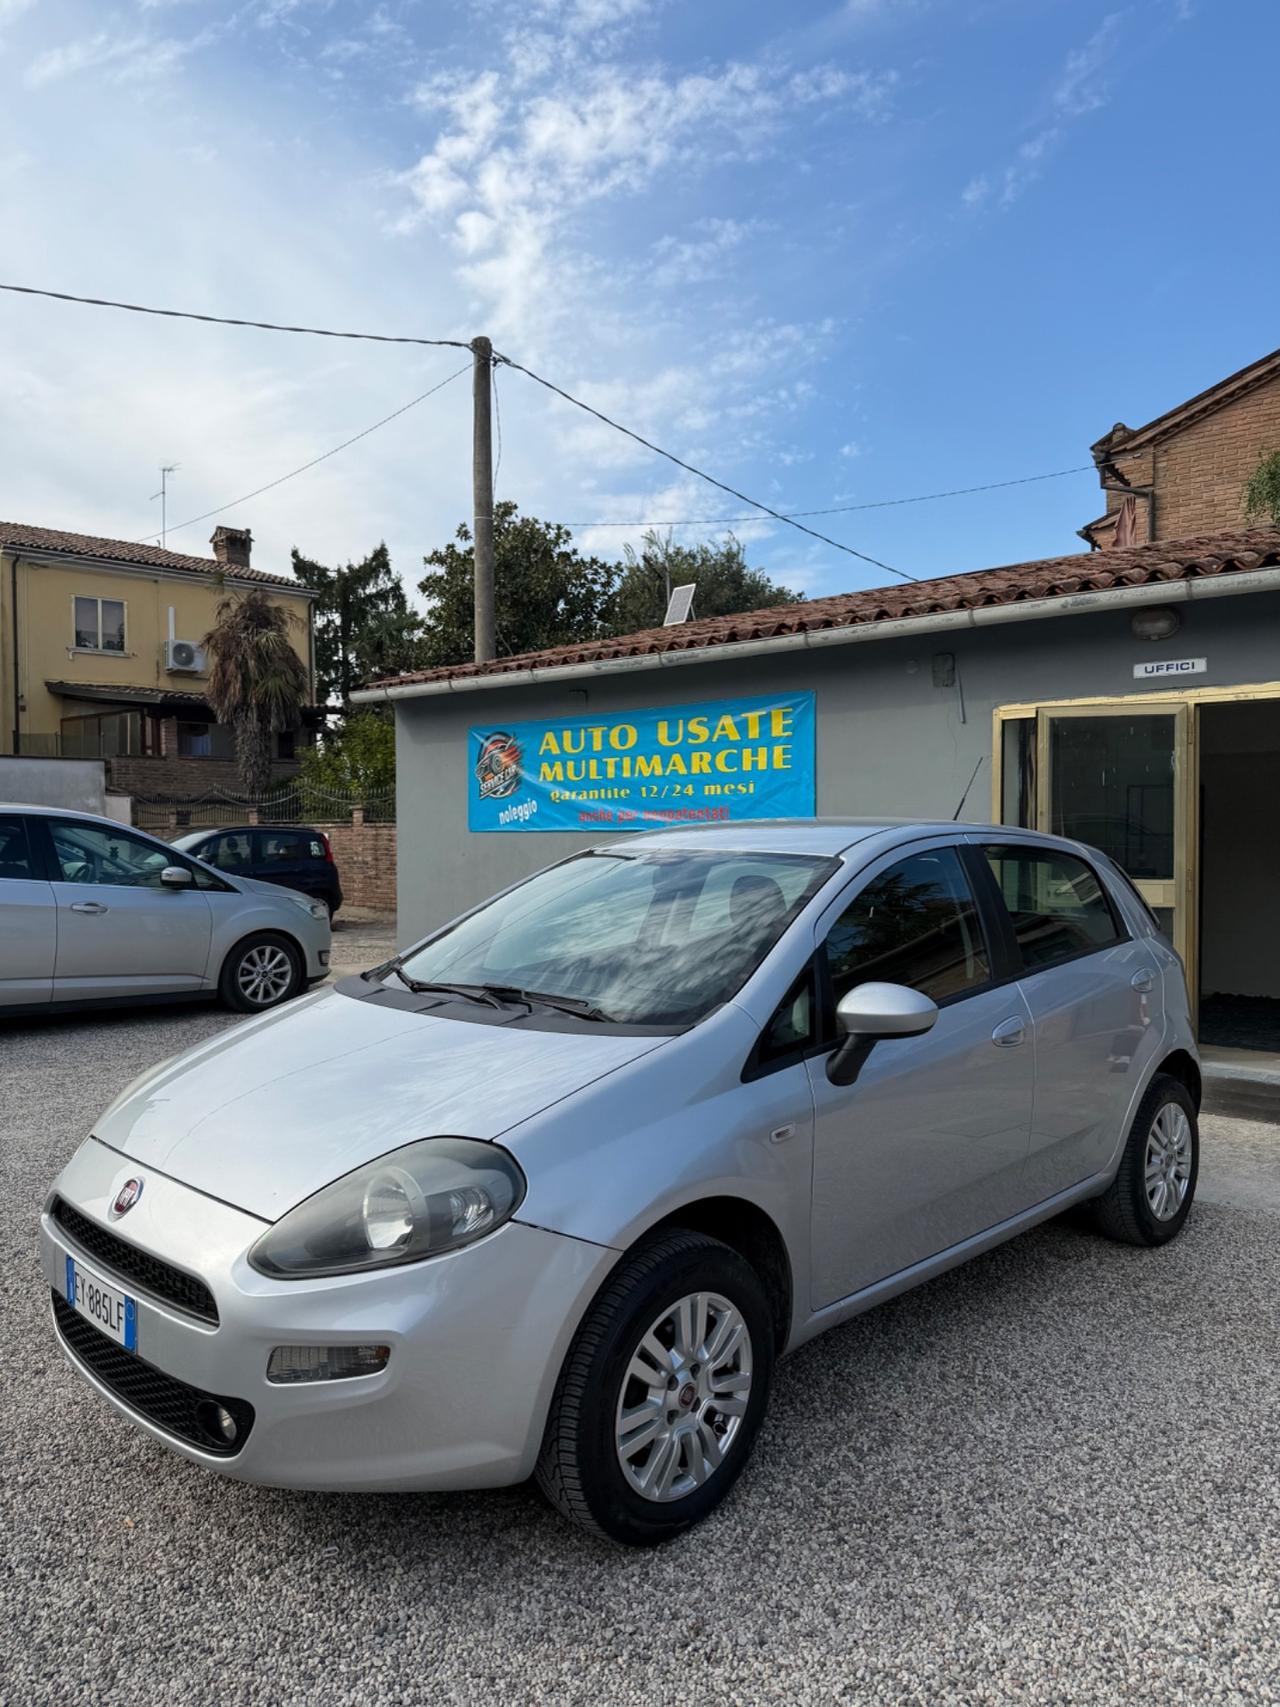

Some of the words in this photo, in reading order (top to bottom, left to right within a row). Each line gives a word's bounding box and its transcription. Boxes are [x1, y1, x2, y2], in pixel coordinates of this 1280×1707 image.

[1144, 661, 1195, 674] UFFICI
[538, 723, 638, 756] AUTO
[657, 707, 794, 746] USATE
[538, 744, 793, 782] MULTIMARCHE
[550, 786, 631, 802] garantite
[640, 784, 695, 799] 12/24
[704, 780, 755, 796] mesi
[498, 798, 537, 825] noleggio
